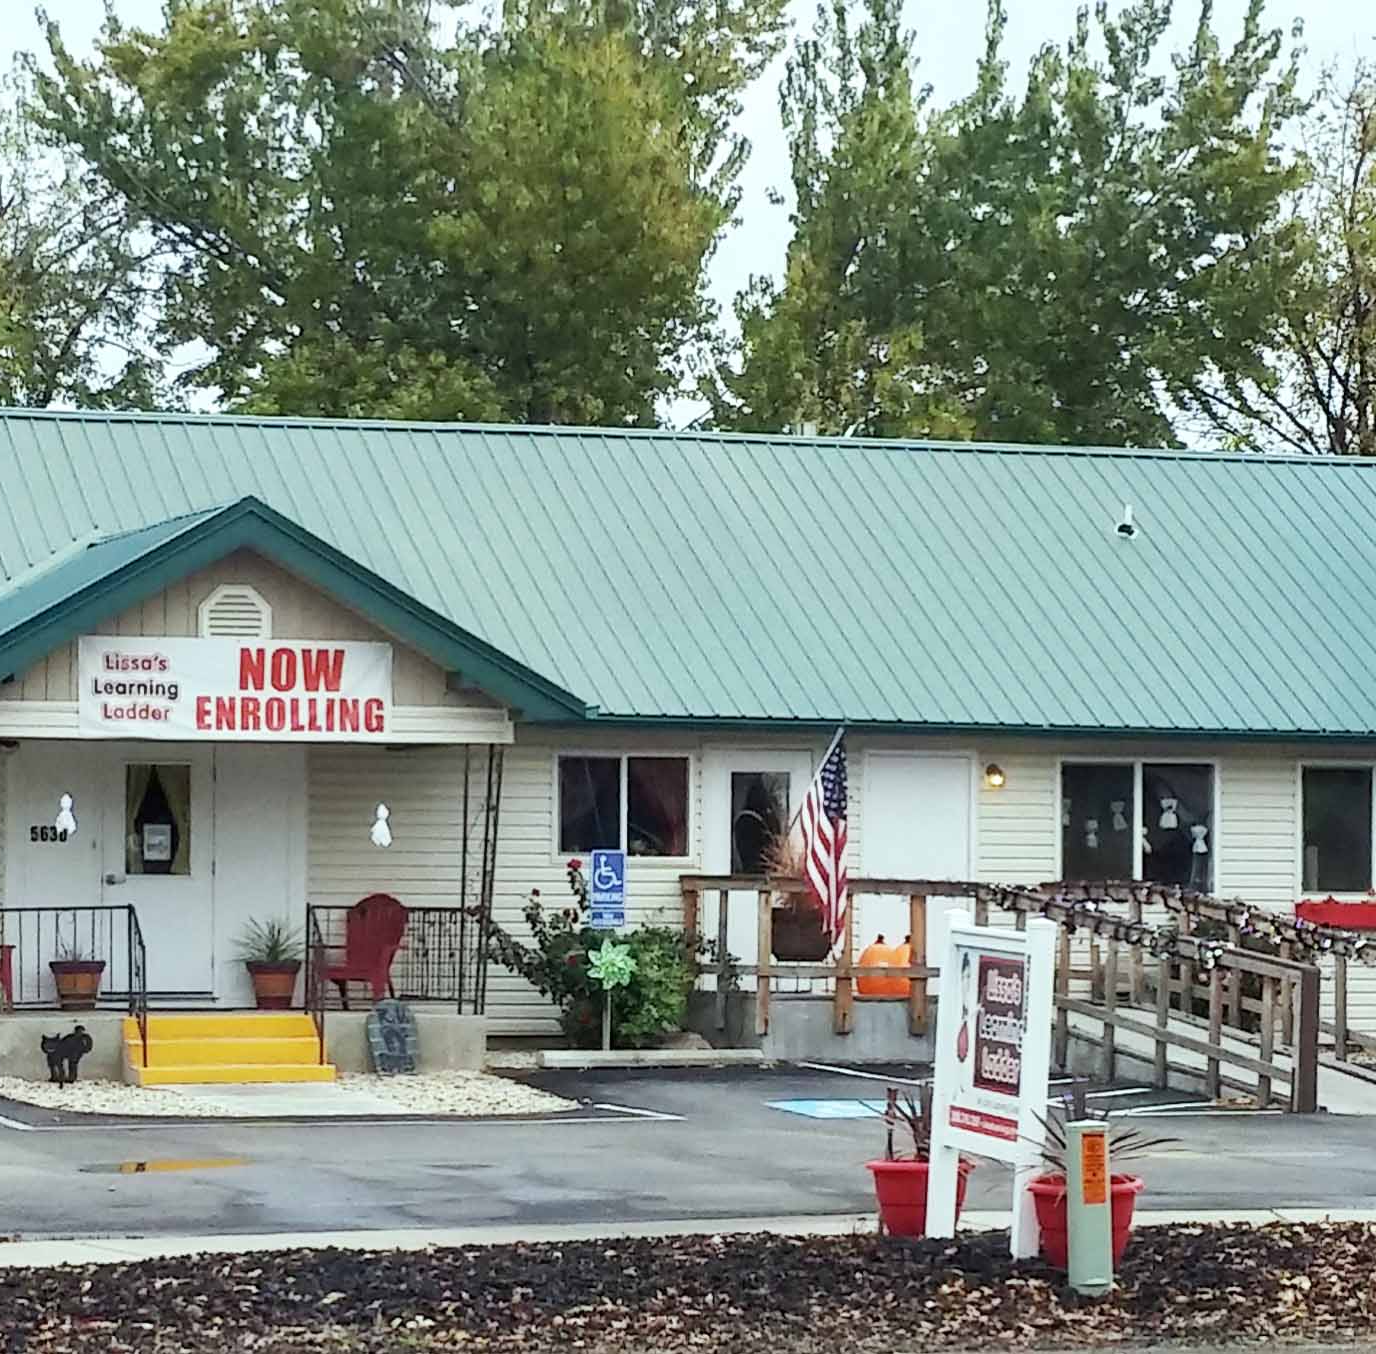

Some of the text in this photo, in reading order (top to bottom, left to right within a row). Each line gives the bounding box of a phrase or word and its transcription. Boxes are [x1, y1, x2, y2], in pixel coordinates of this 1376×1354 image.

[103, 652, 168, 672] Lissa's
[239, 647, 345, 692] NOW
[92, 678, 180, 700] Learning
[102, 702, 171, 722] Ladder
[194, 694, 386, 734] ENROLLING
[981, 1045, 1020, 1085] Ladder
